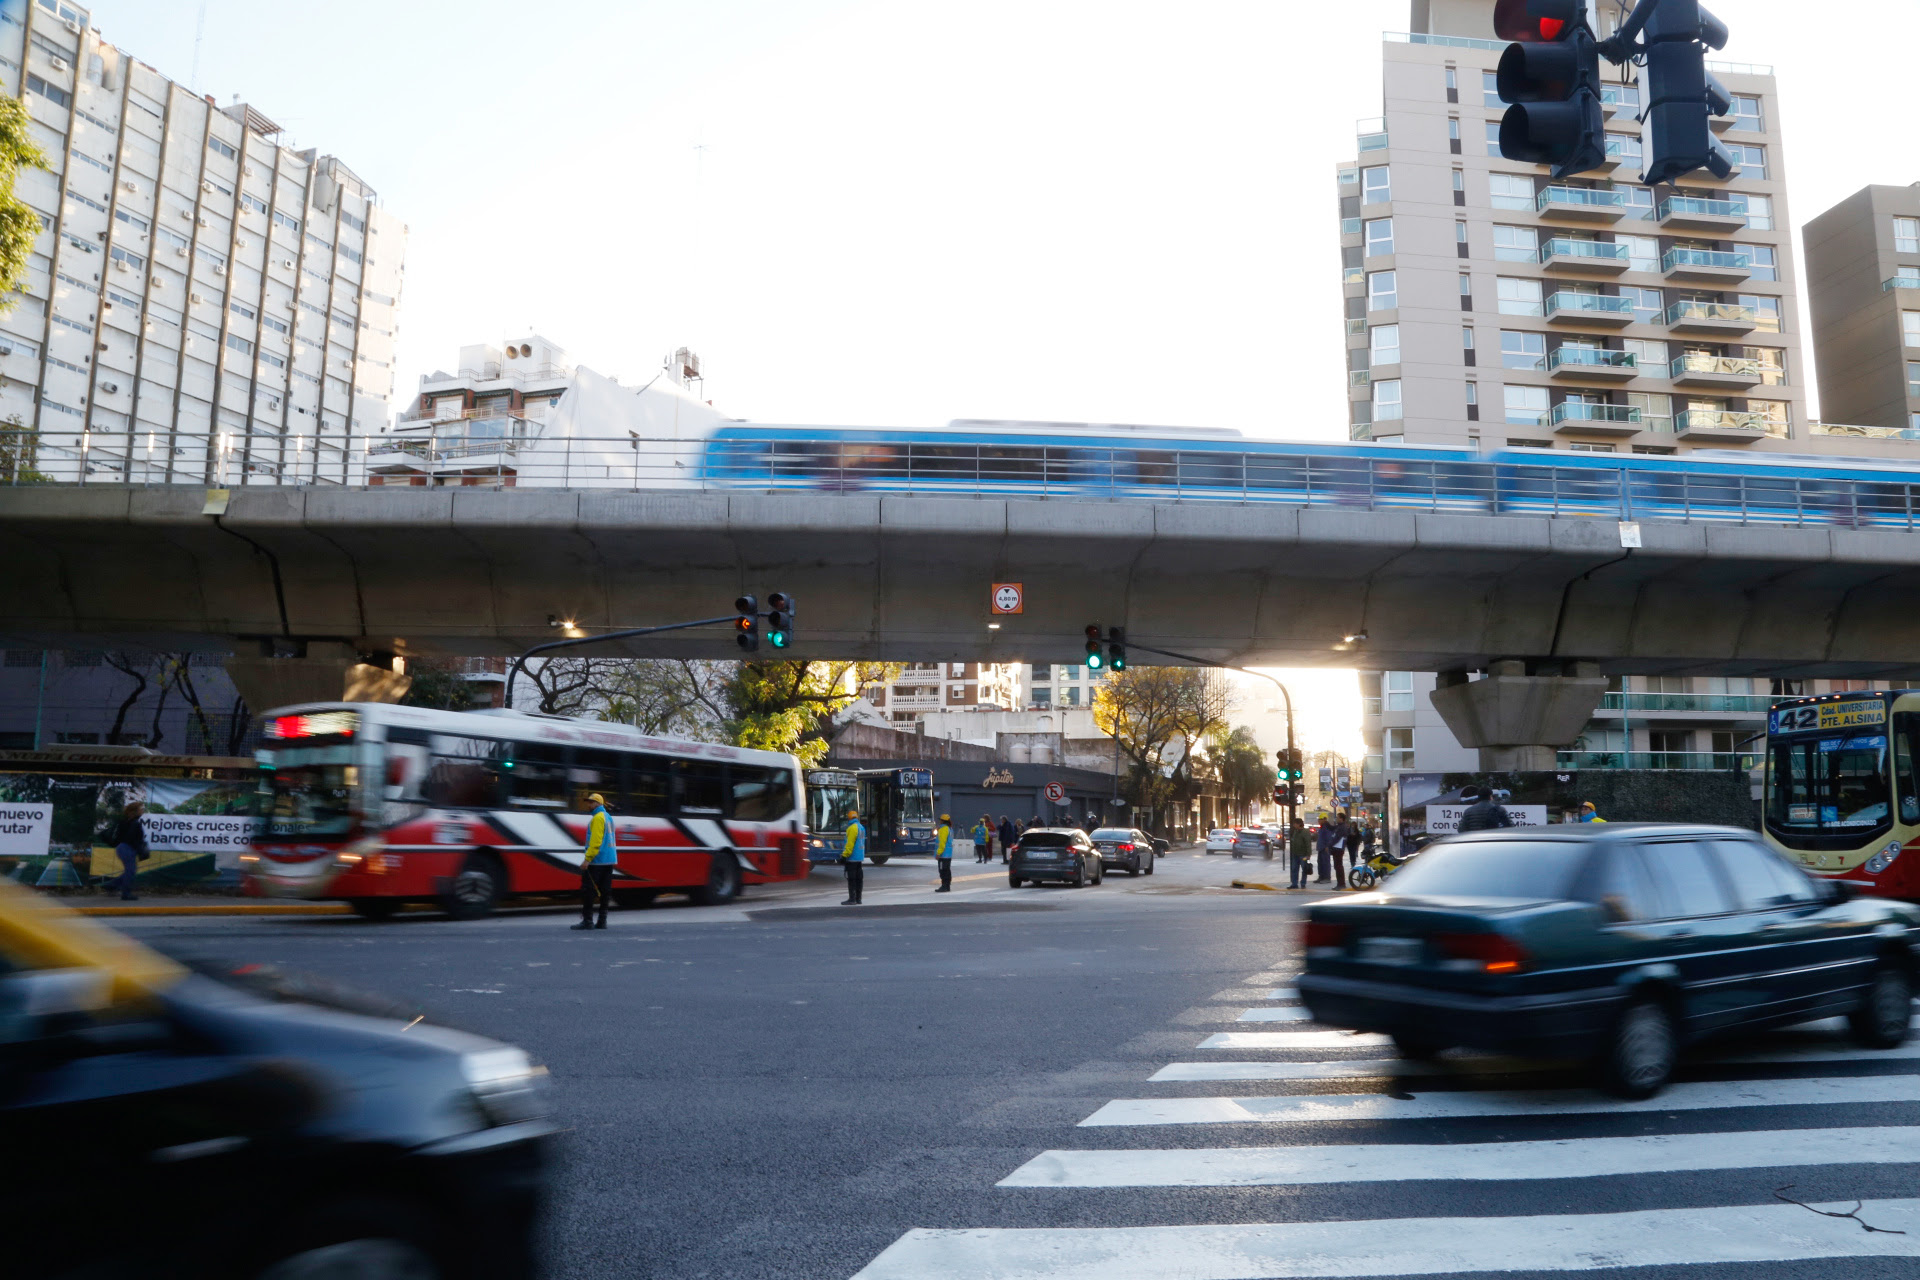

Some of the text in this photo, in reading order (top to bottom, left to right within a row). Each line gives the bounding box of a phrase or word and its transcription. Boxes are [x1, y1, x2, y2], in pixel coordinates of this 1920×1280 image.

[1837, 700, 1883, 714] UNIVERSITARIA
[1780, 707, 1818, 731] 42
[1821, 712, 1883, 727] PTE. ALSINA
[904, 773, 916, 783] 64
[1557, 774, 1570, 782] RER
[1050, 785, 1059, 798] E
[0, 810, 44, 820] nuevo
[1442, 809, 1452, 819] 12
[140, 818, 193, 832] Mejores
[197, 821, 240, 831] cruces
[1432, 822, 1450, 830] con
[151, 832, 199, 845] barrios
[202, 833, 230, 845] más
[1838, 856, 1844, 865] 7
